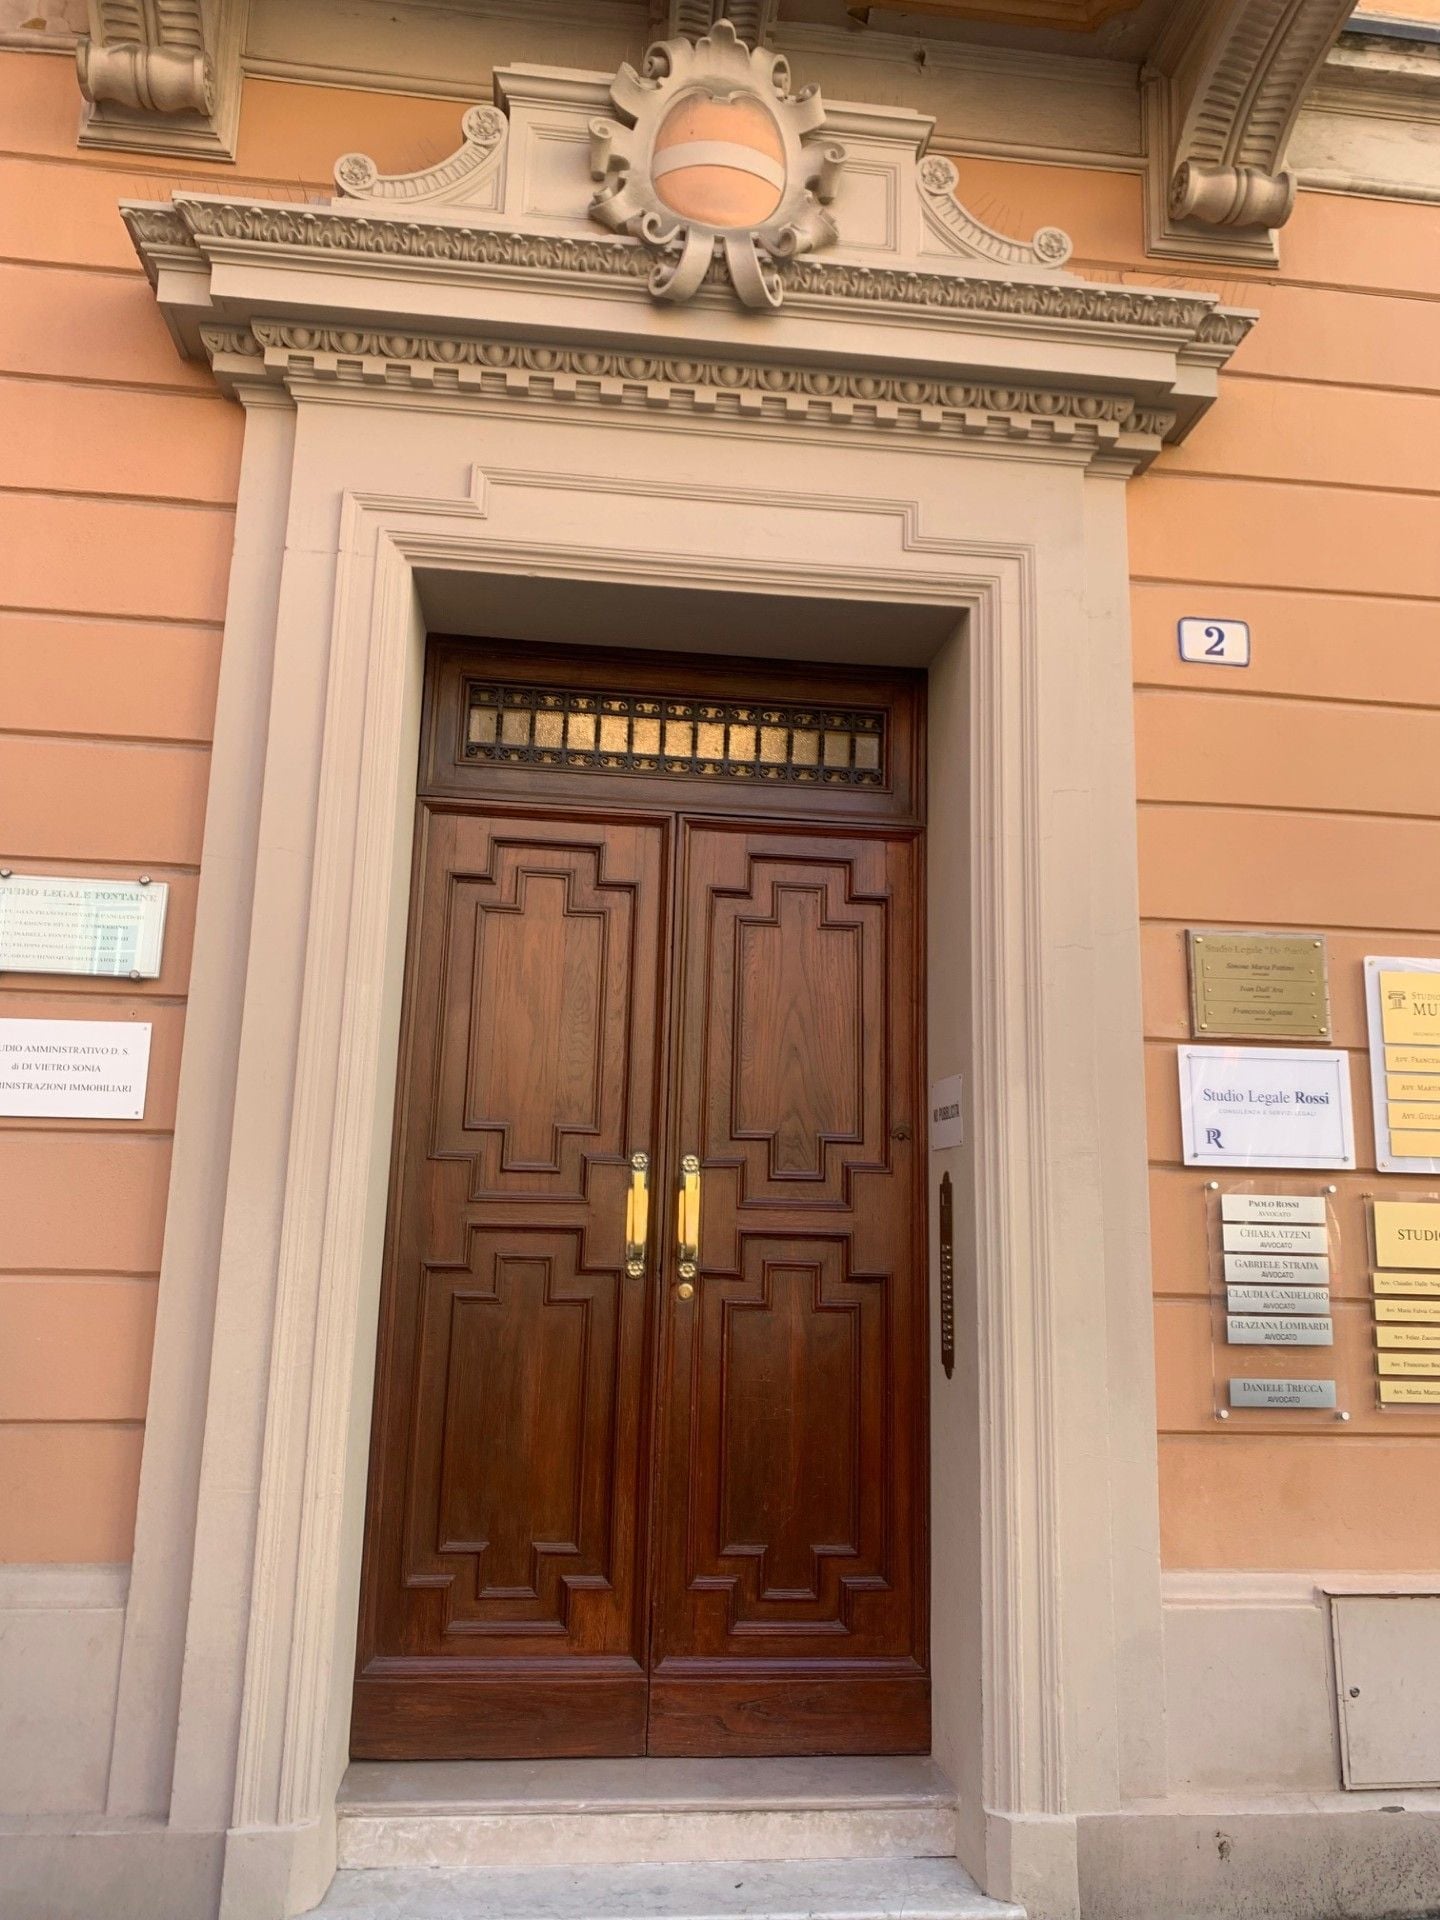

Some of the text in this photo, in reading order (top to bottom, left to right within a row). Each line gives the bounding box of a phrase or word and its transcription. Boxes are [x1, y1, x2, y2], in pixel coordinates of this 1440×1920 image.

[1204, 626, 1225, 656] 2
[43, 888, 92, 899] LEGALE
[96, 891, 156, 902] FONTAINE
[1412, 1003, 1440, 1016] MU
[25, 1045, 109, 1055] AMMINISTRATIVO
[11, 1062, 19, 1070] di
[34, 1063, 70, 1071] VIETRO
[72, 1064, 102, 1073] SONIA
[0, 1081, 132, 1093] INISTRAZIONI IMMOBILIARI
[1203, 1088, 1330, 1106] Studio Legale Rossi
[1248, 1200, 1274, 1208] PAOLO
[1240, 1228, 1311, 1240] CHIARA ATZENI
[1397, 1228, 1440, 1241] STUDI
[1235, 1259, 1319, 1270] GABRIELE STRADA
[1261, 1271, 1294, 1279] AVVOCATO
[1228, 1289, 1329, 1300] CLAUDIA CANDELORO
[1230, 1320, 1329, 1331] GRAZIANA LOMBARDI
[1264, 1333, 1298, 1341] AVVOCATO
[1242, 1382, 1323, 1393] DANIELE TRECCA
